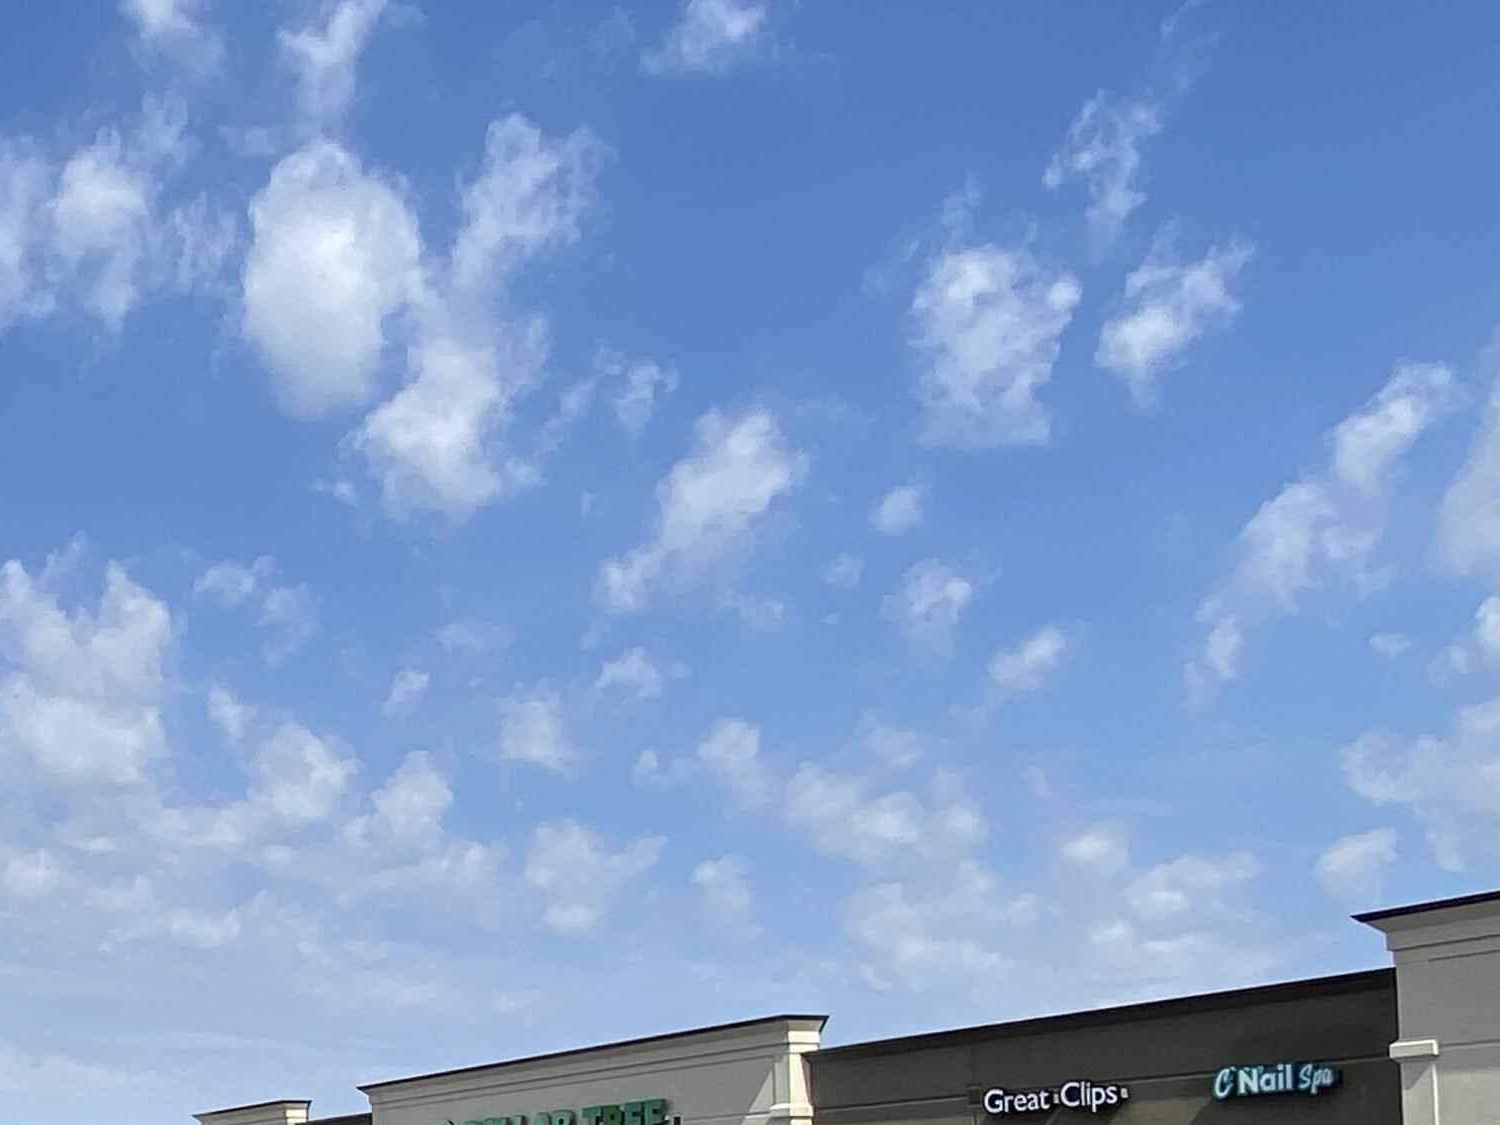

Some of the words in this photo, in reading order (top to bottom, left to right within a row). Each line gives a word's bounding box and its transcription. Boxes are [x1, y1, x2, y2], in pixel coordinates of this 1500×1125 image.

[1237, 1064, 1293, 1095] Nail
[1298, 1064, 1334, 1094] Spa
[984, 1089, 1050, 1114] Great
[1060, 1081, 1118, 1113] Clips
